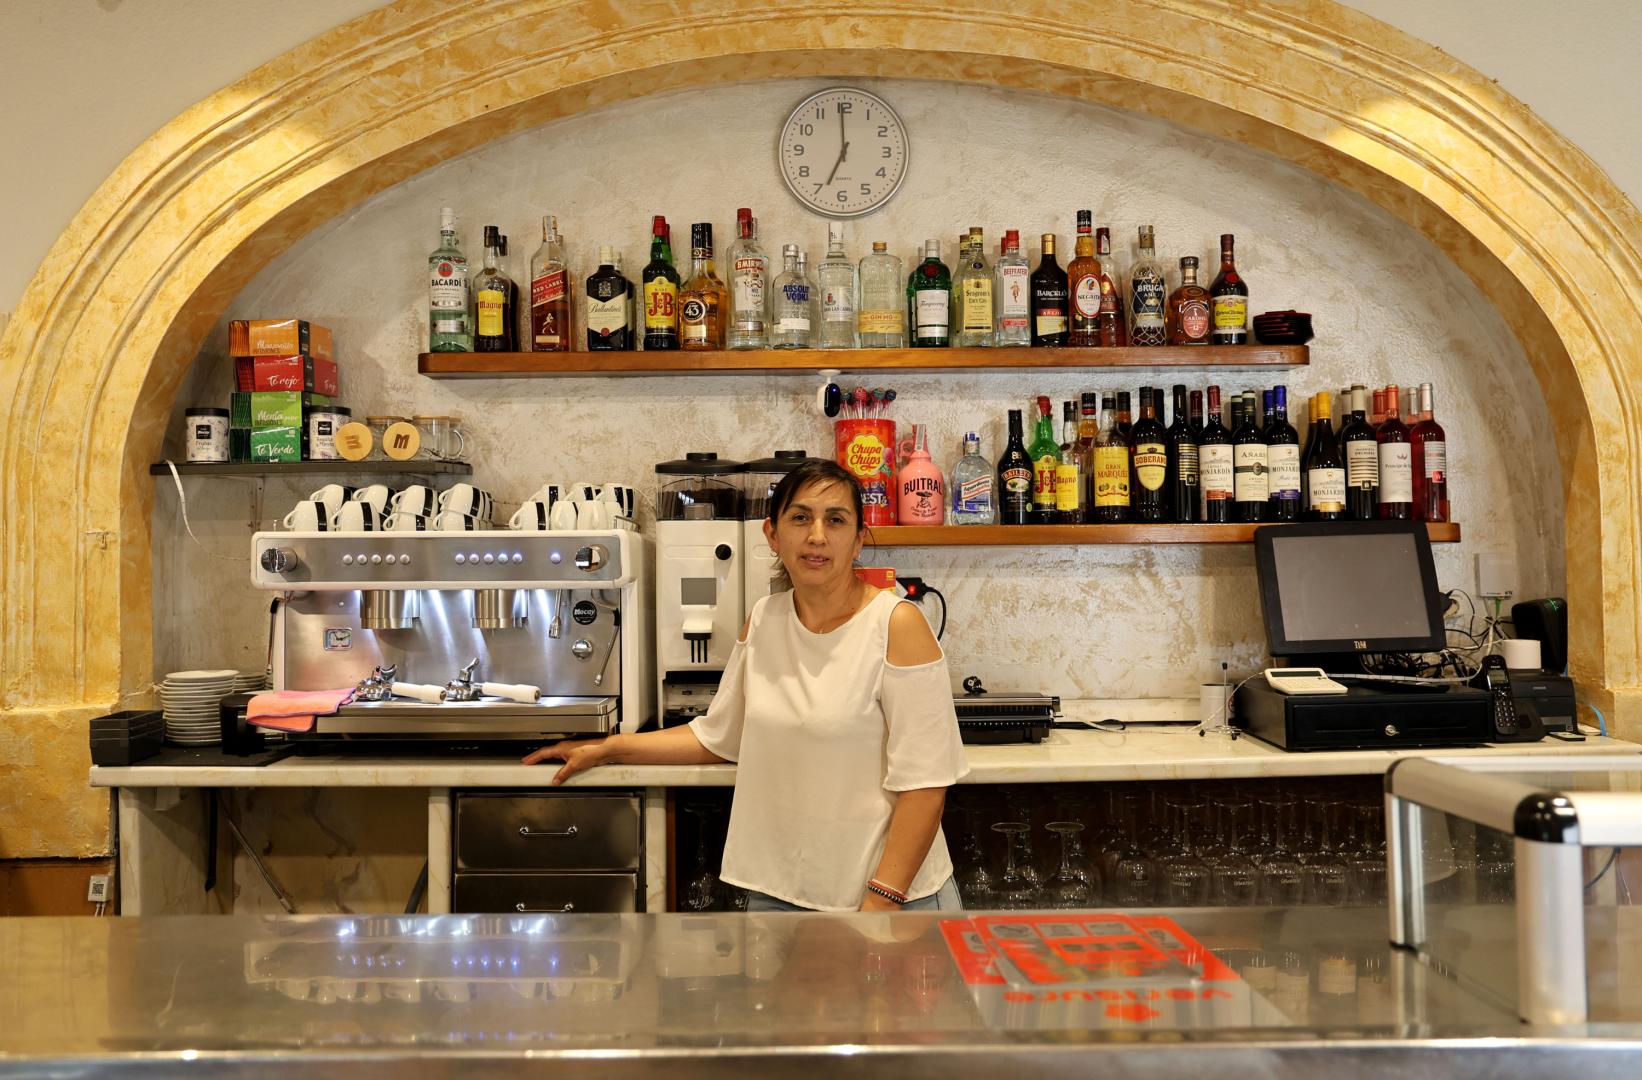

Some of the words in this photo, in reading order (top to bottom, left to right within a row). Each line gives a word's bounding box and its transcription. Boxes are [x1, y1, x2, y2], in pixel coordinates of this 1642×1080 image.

[816, 108, 825, 120] 11
[837, 102, 852, 114] 12
[866, 109, 870, 121] 1
[800, 124, 814, 136] 10
[877, 125, 888, 138] 2
[793, 144, 805, 156] 9
[881, 146, 892, 159] 3
[798, 165, 810, 178] 8
[875, 166, 887, 178] 4
[813, 183, 824, 195] 7
[860, 183, 871, 195] 5
[836, 190, 848, 202] 6
[684, 303, 700, 317] 43
[393, 433, 410, 449] M
[268, 442, 295, 457] Verde
[851, 443, 882, 457] Chupa
[850, 453, 881, 467] Chups
[1004, 470, 1032, 479] BAILEYS
[904, 477, 943, 496] BUITRAL
